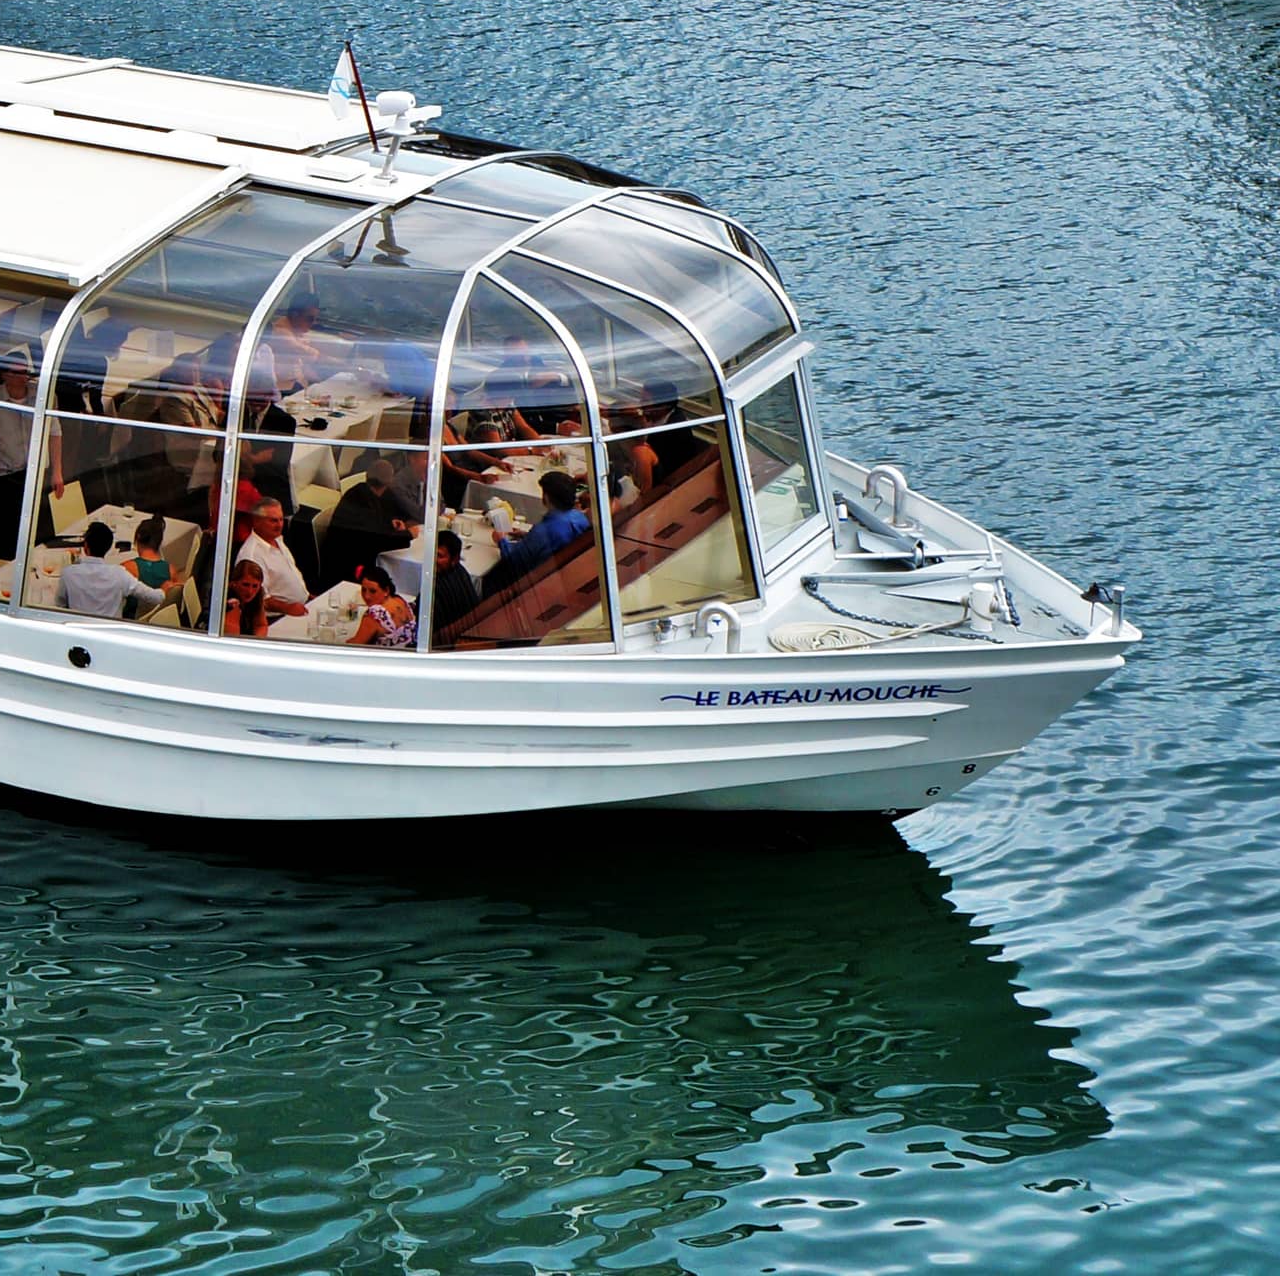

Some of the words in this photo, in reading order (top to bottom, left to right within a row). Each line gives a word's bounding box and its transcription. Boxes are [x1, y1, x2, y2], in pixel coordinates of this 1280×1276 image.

[694, 689, 720, 706] LE
[727, 688, 821, 706] BATEAU
[824, 684, 942, 702] MOUCHE
[961, 763, 977, 774] 8
[926, 786, 942, 797] 6
